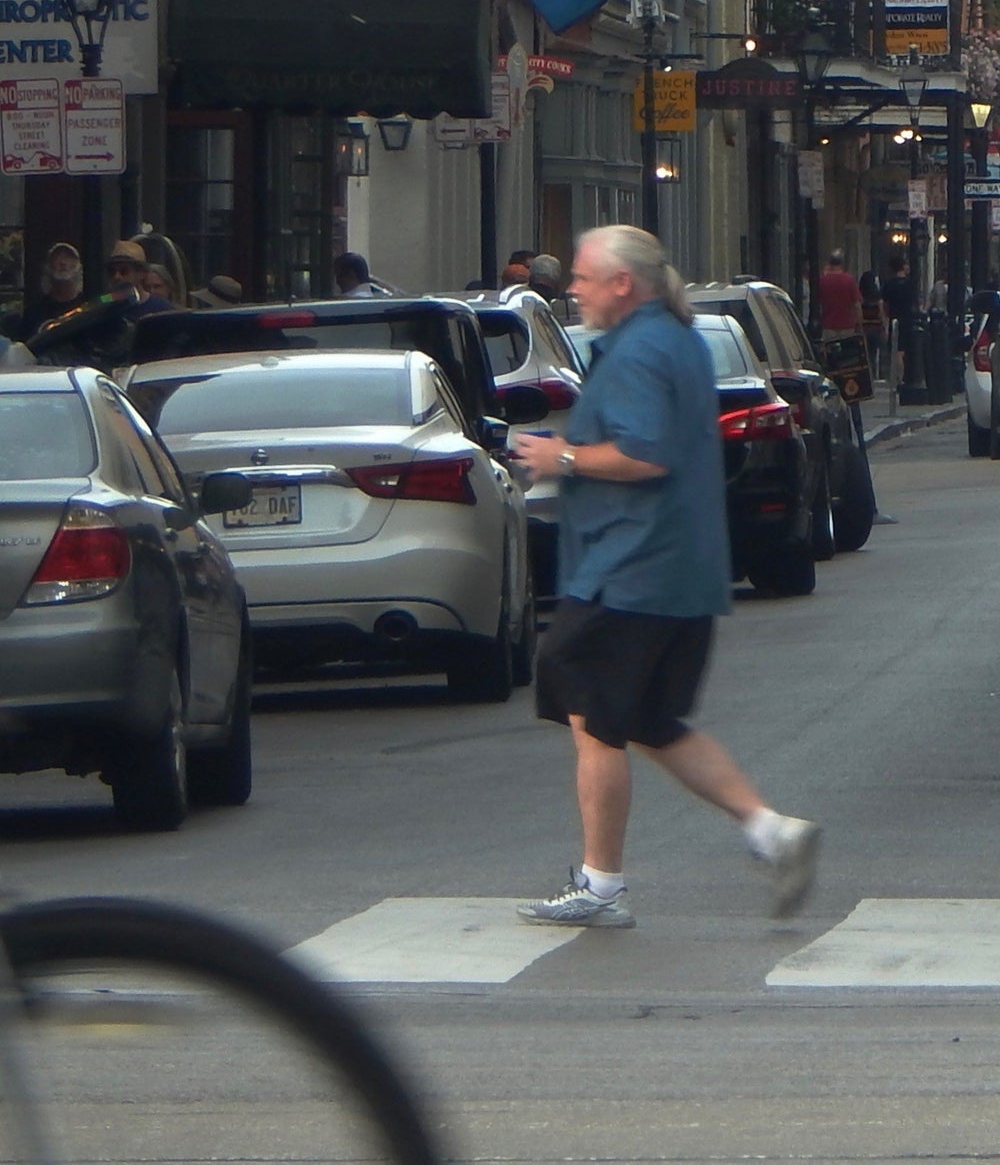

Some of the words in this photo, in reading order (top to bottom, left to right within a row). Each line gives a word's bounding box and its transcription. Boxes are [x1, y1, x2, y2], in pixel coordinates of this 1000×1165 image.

[0, 86, 17, 104] NO
[17, 88, 58, 102] STOPPING
[65, 86, 81, 104] NO
[82, 87, 121, 100] PARKING
[702, 80, 797, 96] JUSTINE
[68, 117, 121, 129] PASSENGER
[82, 135, 108, 146] ZONE
[966, 184, 984, 194] ONE
[268, 496, 297, 515] DAF
